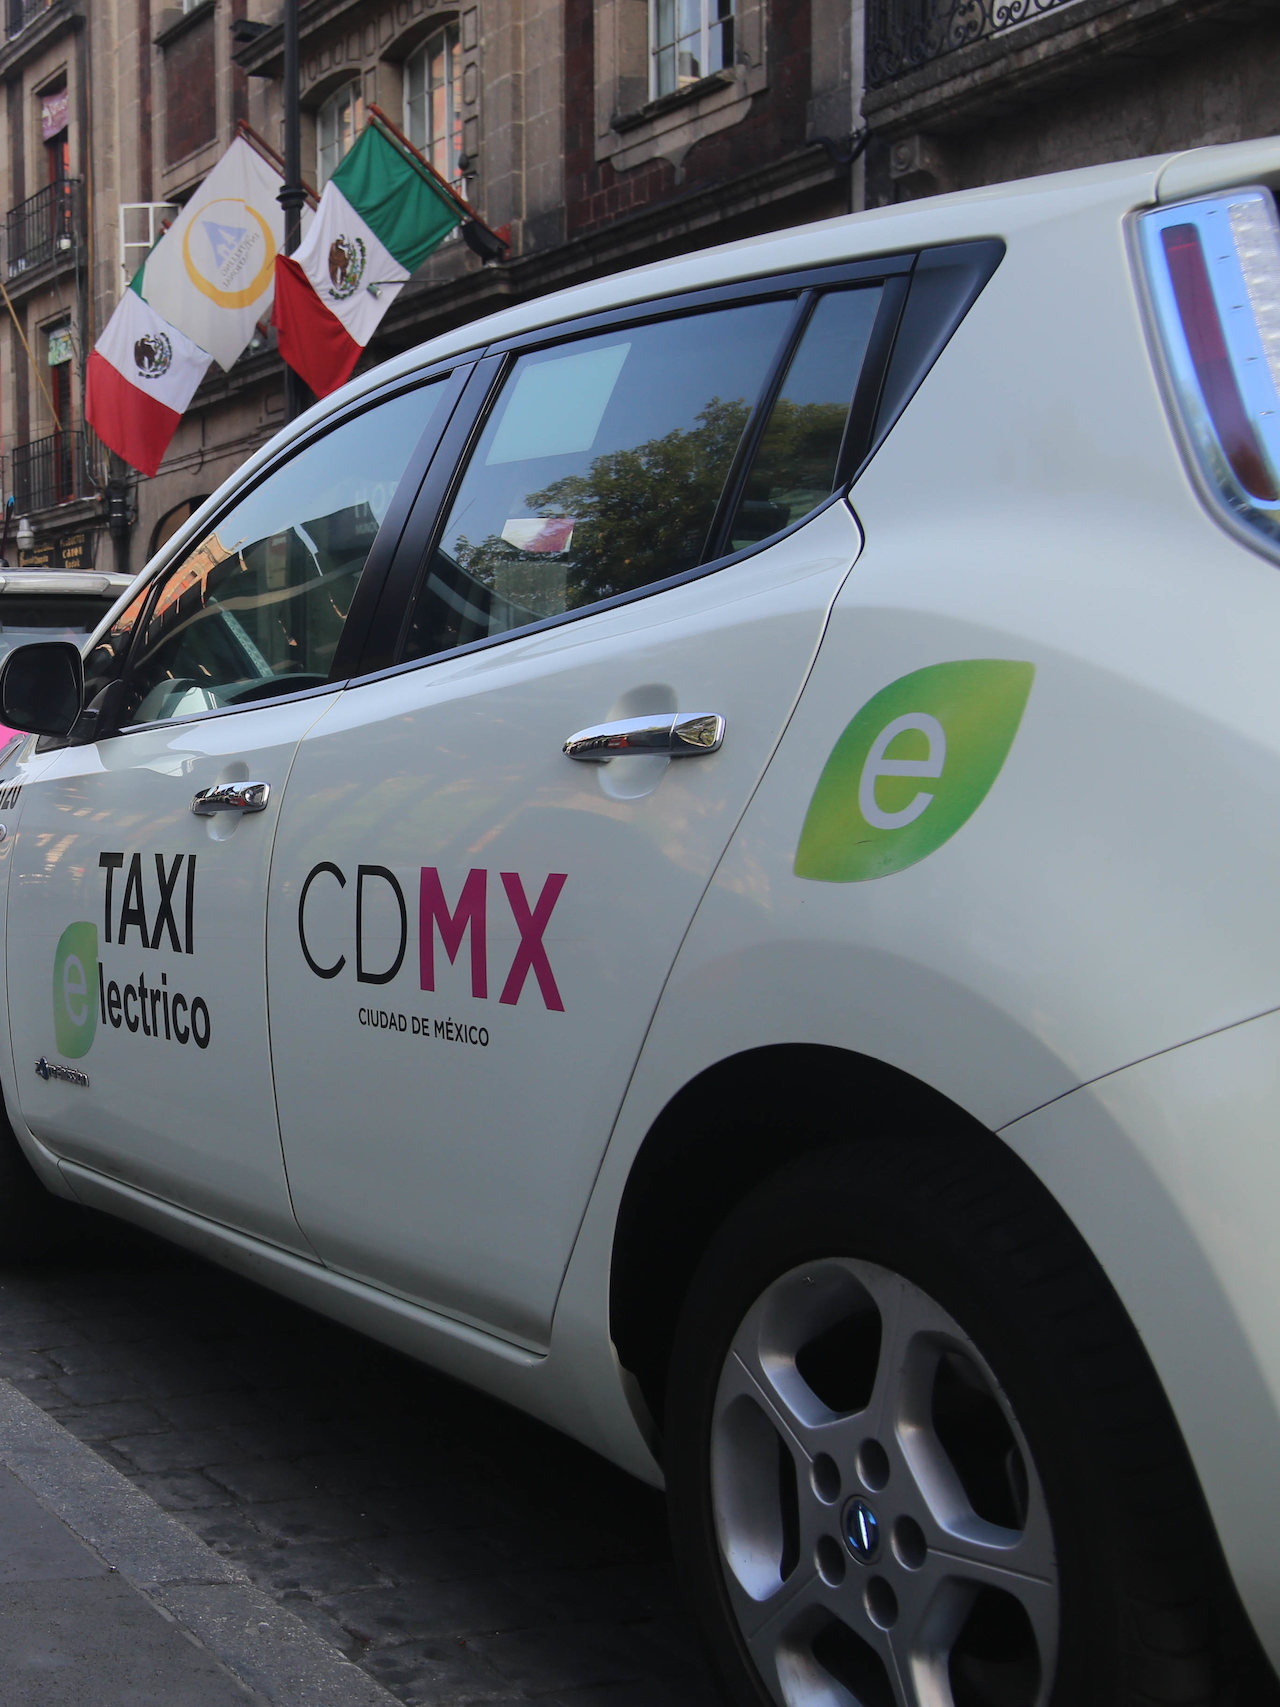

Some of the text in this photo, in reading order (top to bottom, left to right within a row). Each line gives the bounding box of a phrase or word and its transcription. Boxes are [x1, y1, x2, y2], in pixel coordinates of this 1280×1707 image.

[858, 712, 946, 830] e
[98, 851, 197, 955] TAXI
[298, 861, 569, 1013] CDMX
[358, 1007, 490, 1047] CIUDAD DE MÉXICO
